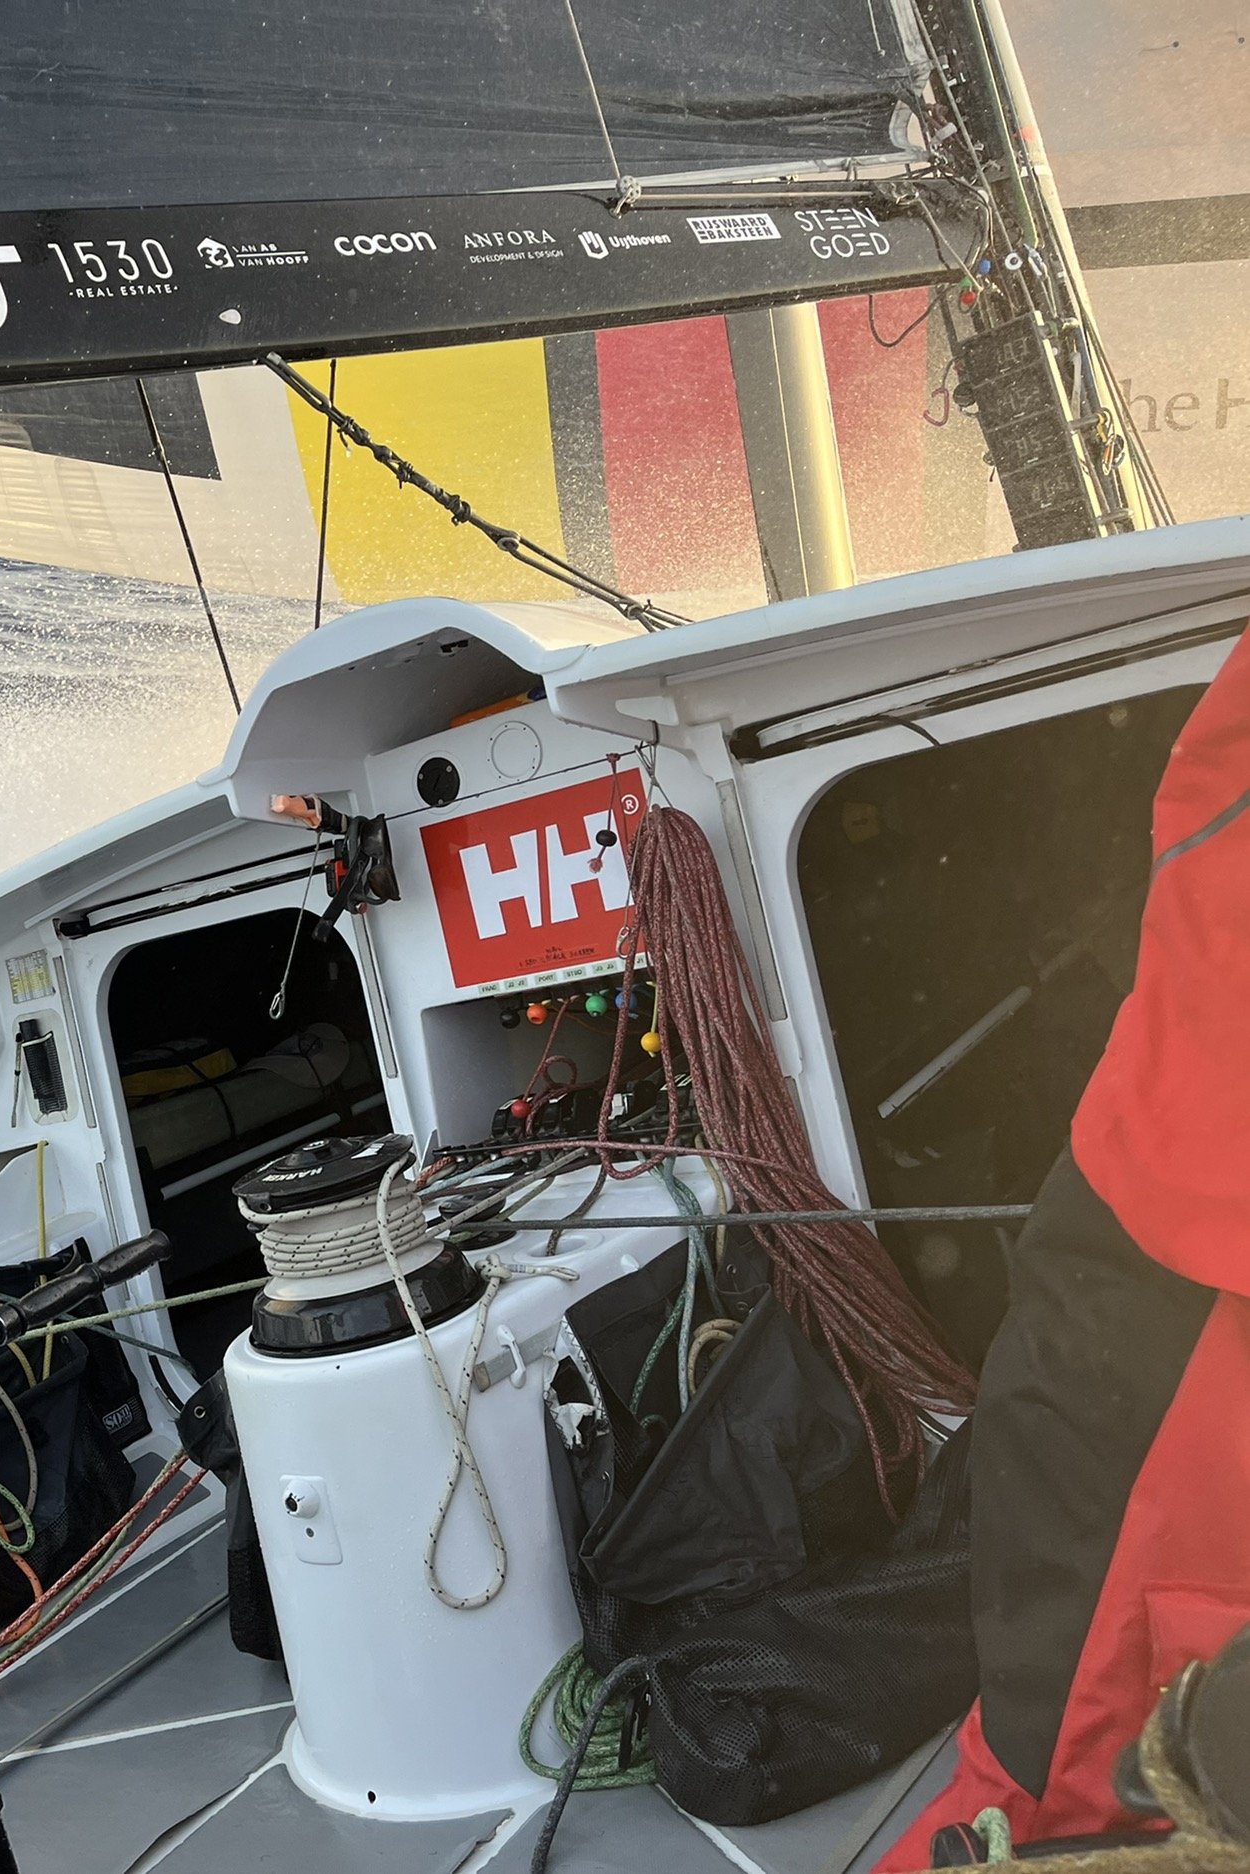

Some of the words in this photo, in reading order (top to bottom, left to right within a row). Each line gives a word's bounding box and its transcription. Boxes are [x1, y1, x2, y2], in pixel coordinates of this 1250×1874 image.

[691, 216, 767, 230] RIJSWAARD
[794, 207, 879, 232] STEEN
[464, 228, 557, 249] ANFORA
[608, 233, 672, 249] Uijthoven
[706, 226, 774, 239] BAKSTEEN
[810, 232, 890, 259] GOED
[47, 238, 174, 284] 1530
[469, 252, 527, 264] DEVELOPMENT
